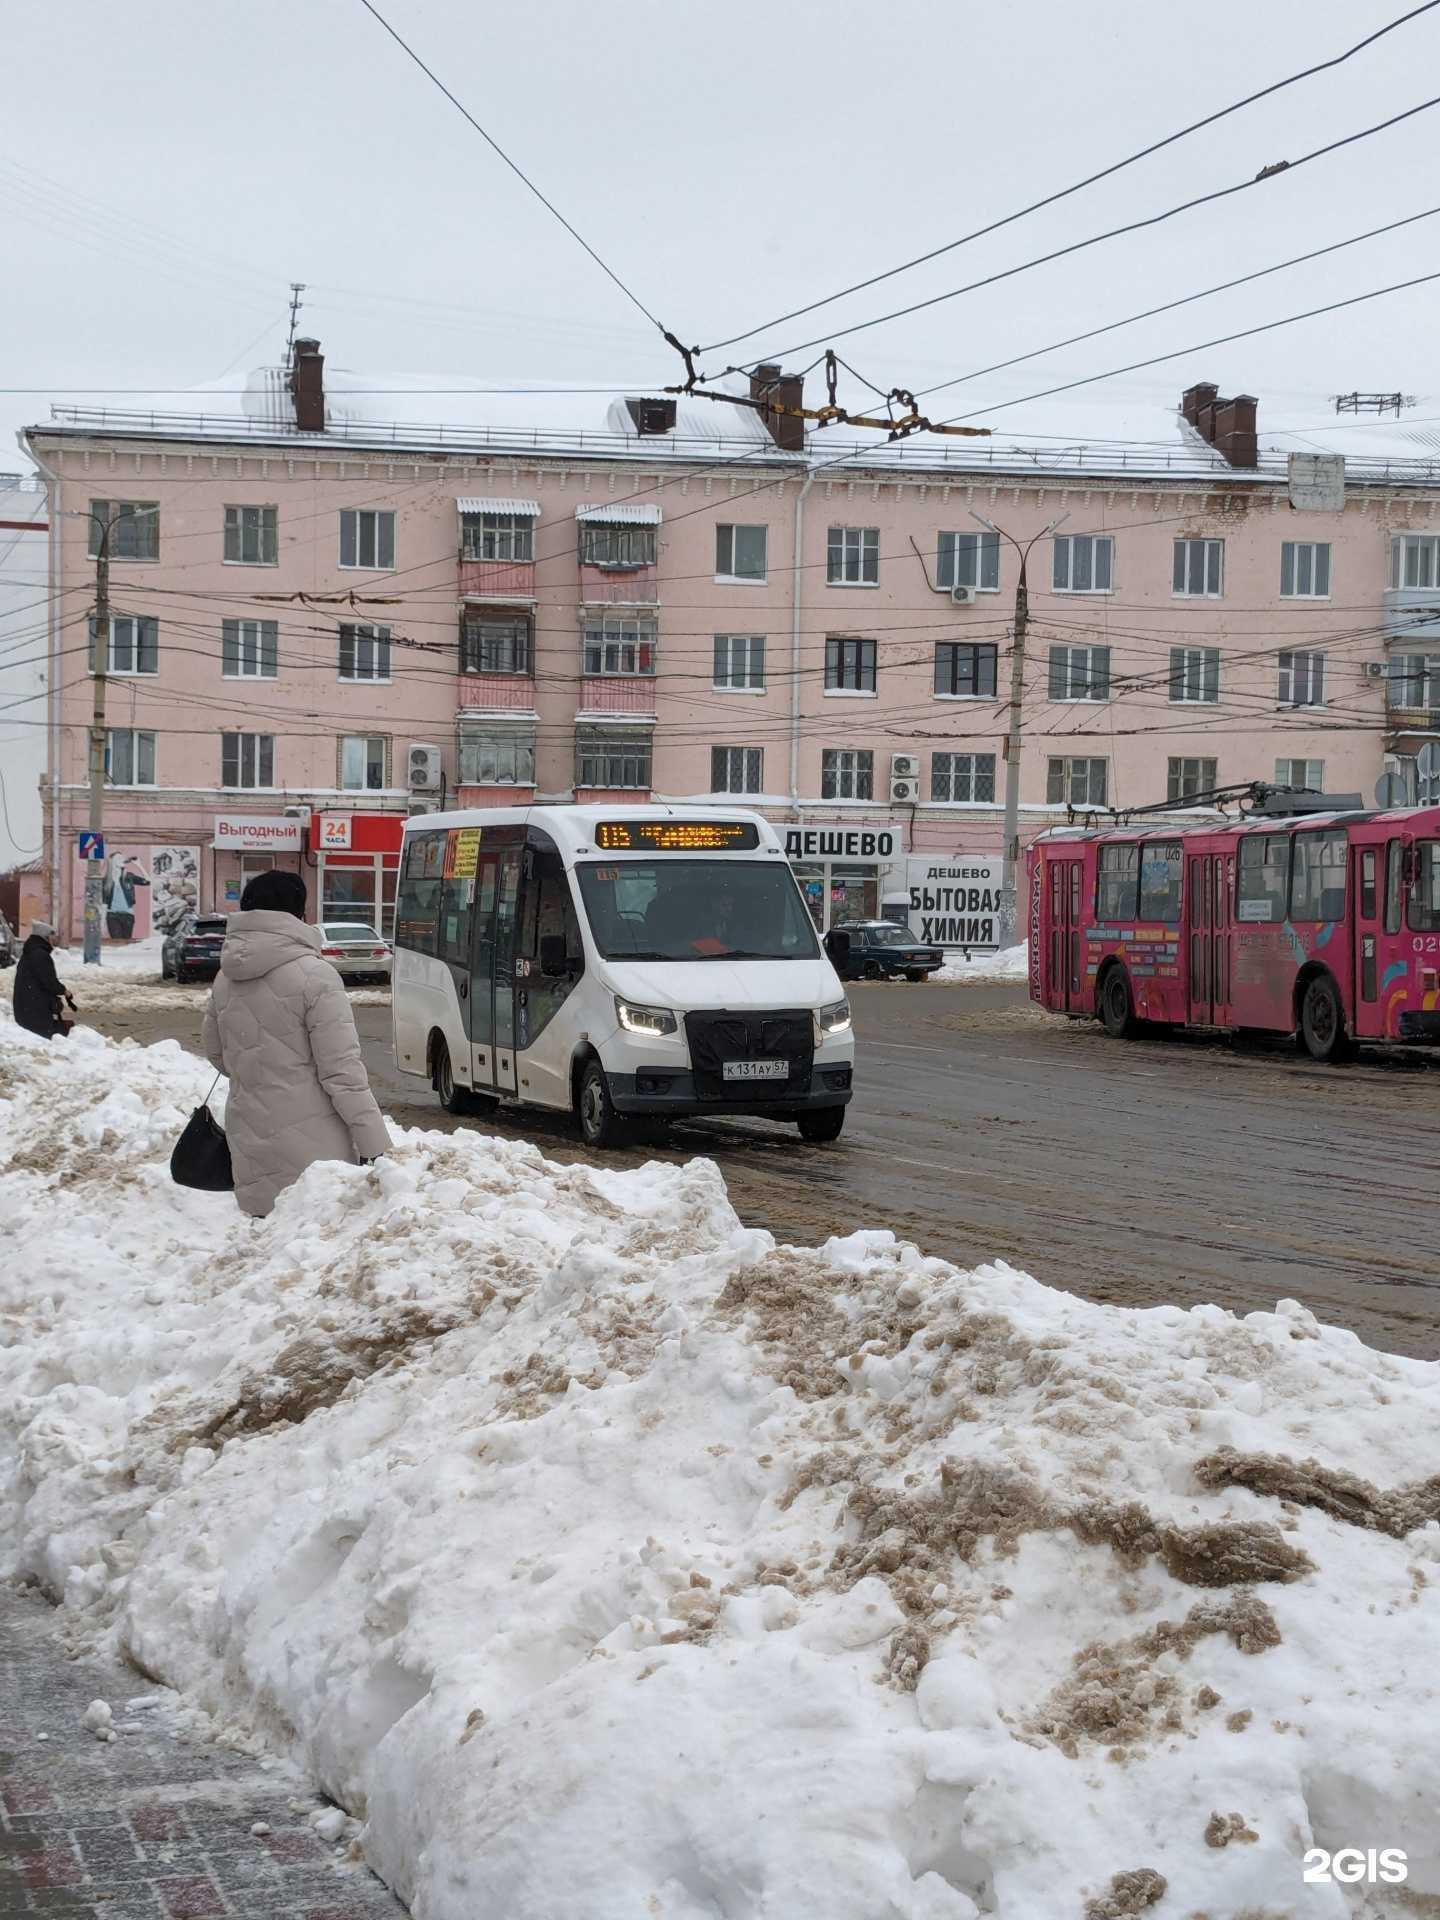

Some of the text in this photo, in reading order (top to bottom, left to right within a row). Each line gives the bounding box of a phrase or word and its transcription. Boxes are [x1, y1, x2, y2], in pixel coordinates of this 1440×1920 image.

[219, 821, 297, 838] Выгодный
[326, 822, 346, 836] 24
[785, 830, 894, 859] ДЕШЕВО
[927, 867, 991, 880] ДЕШЕВО
[920, 917, 993, 942] ХИМИЯ
[1032, 862, 1041, 1000] ПАНОРАМА
[1412, 936, 1440, 953] 02
